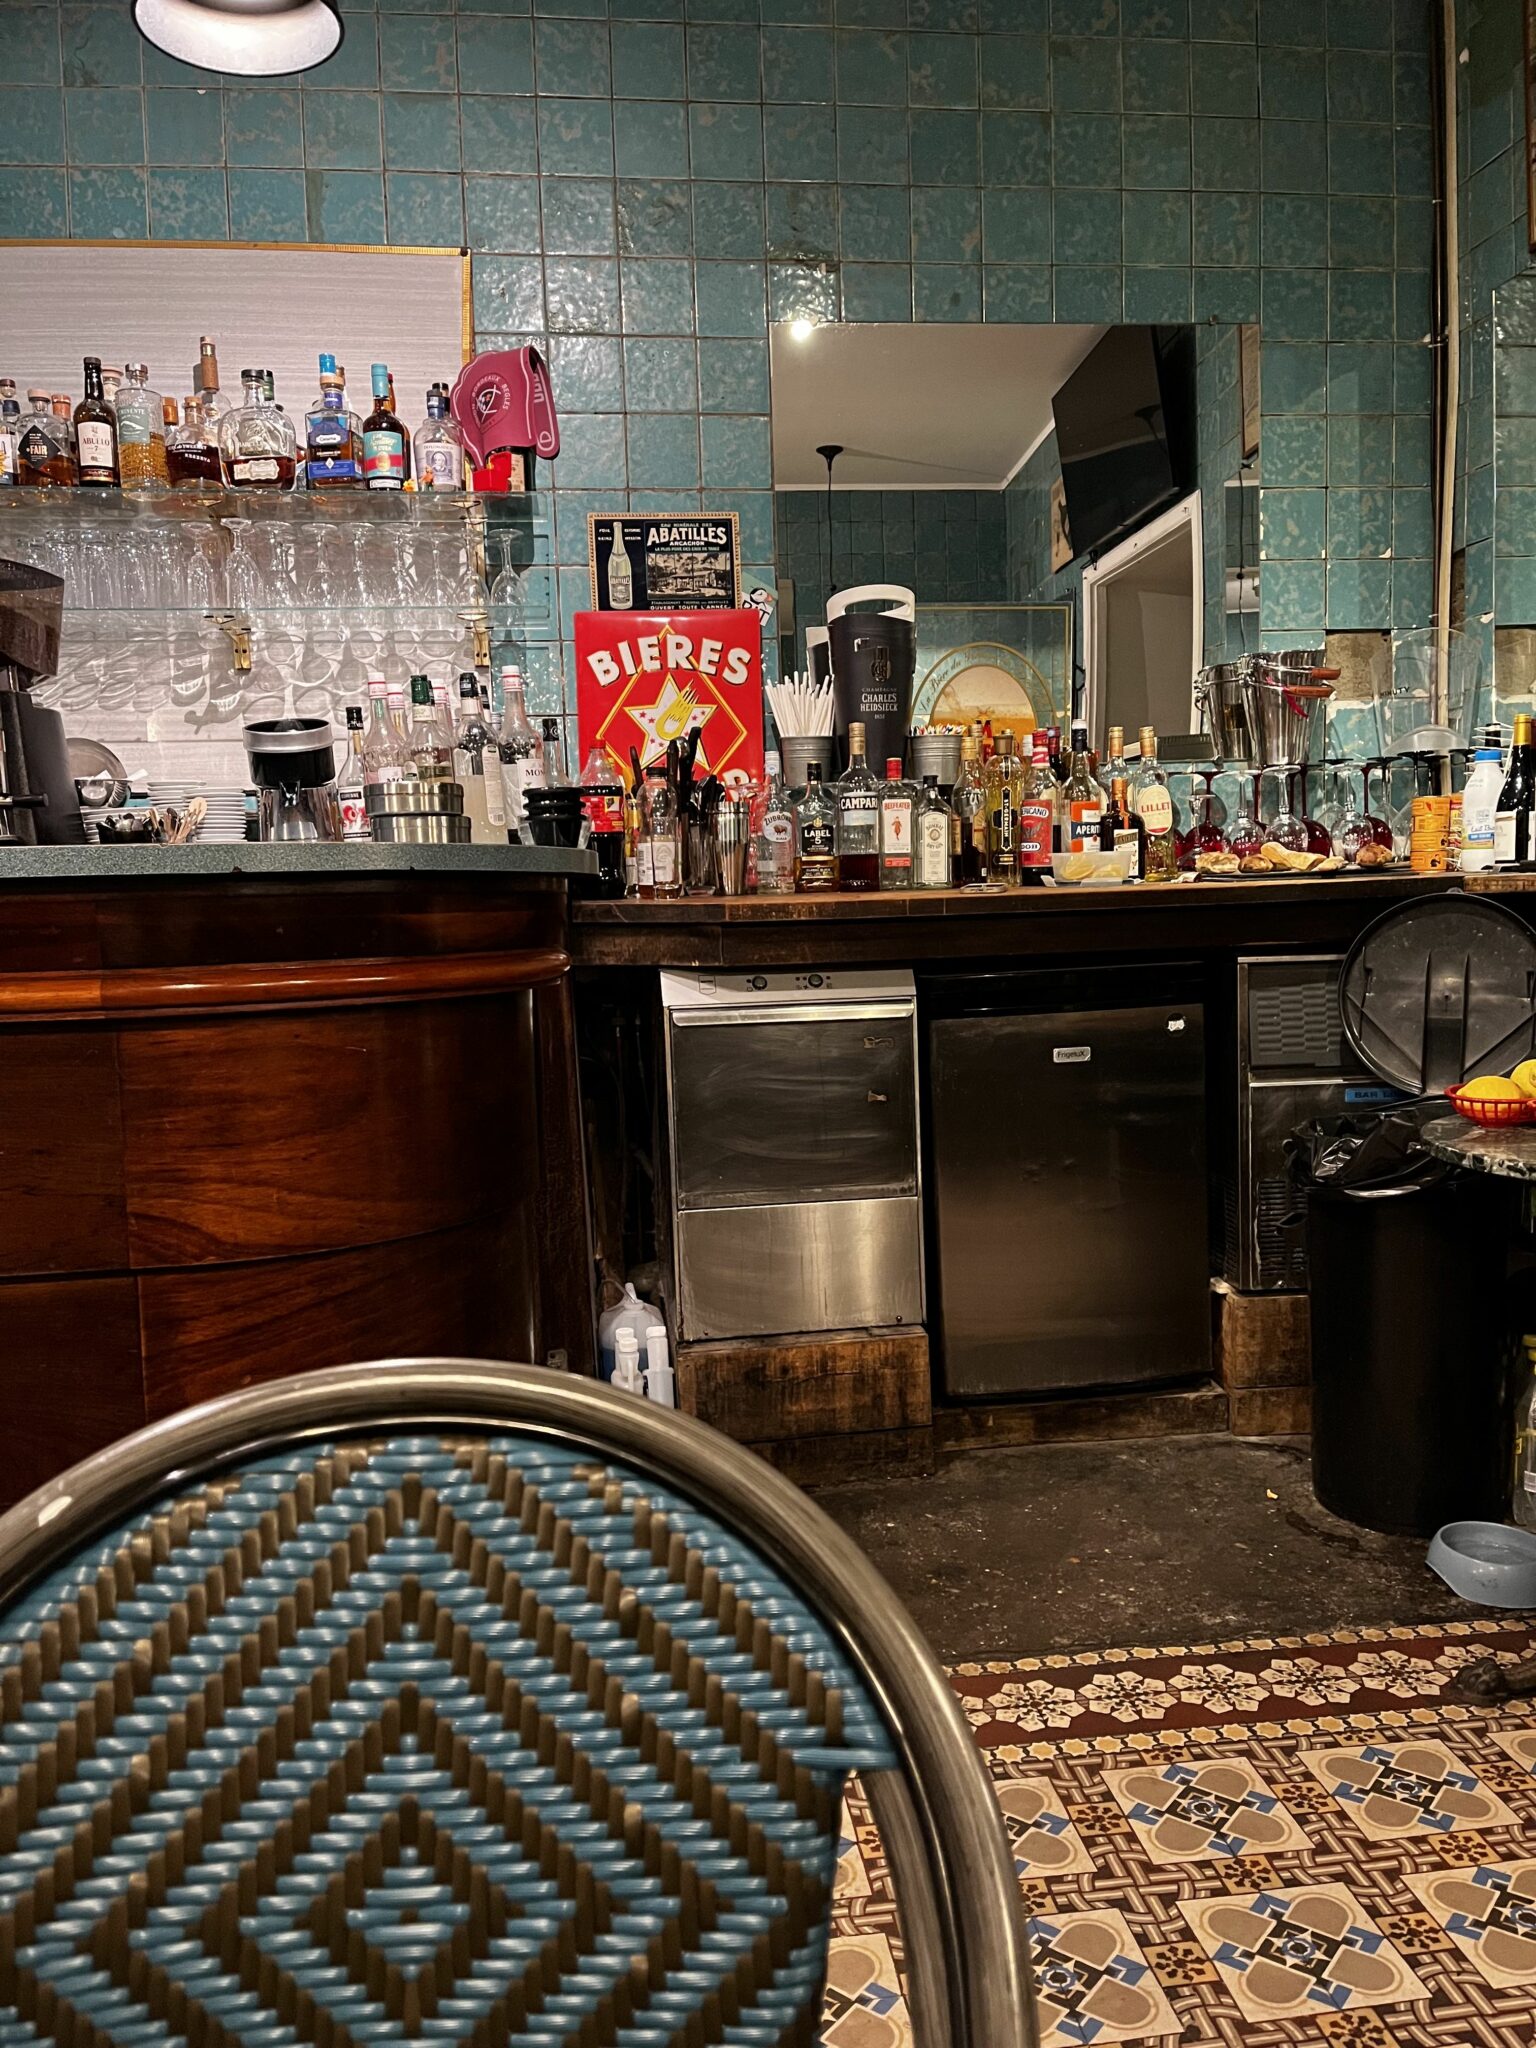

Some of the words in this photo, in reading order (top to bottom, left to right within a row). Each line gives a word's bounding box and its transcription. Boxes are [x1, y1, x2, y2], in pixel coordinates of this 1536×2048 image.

[30, 444, 48, 456] FAIR
[646, 526, 728, 547] ABATILLES
[586, 633, 752, 688] BIERES
[861, 693, 898, 703] CHARLES
[860, 703, 898, 712] HEIDSIECK
[884, 801, 911, 811] BEEFEATER
[804, 829, 832, 838] LABEL
[814, 836, 822, 845] 5
